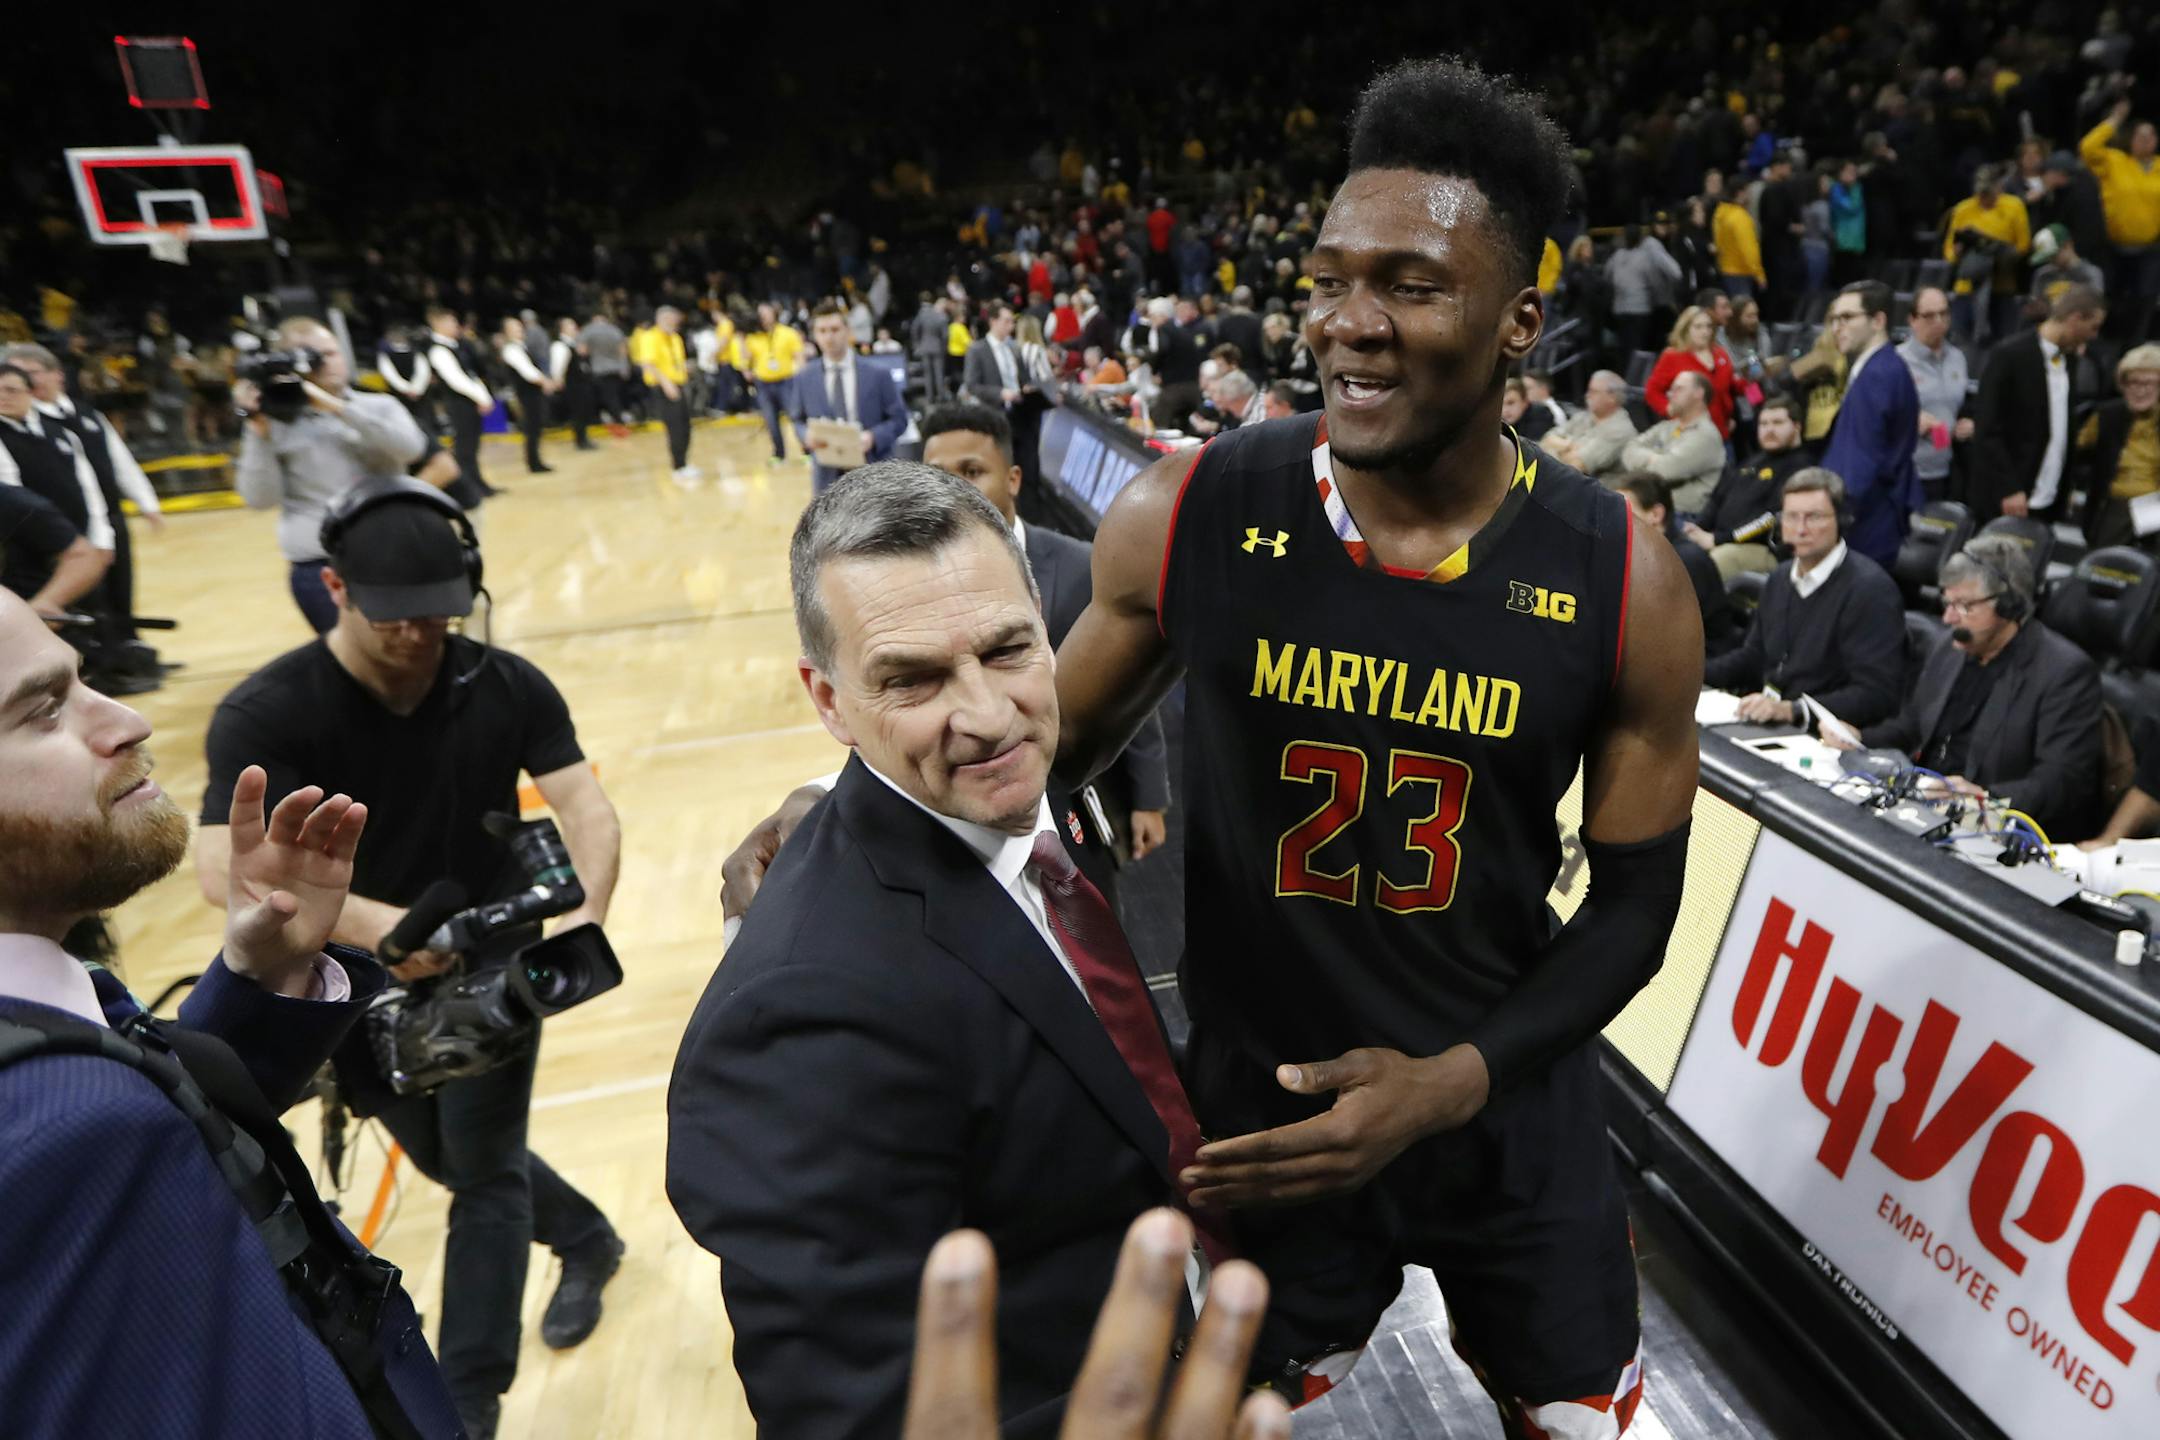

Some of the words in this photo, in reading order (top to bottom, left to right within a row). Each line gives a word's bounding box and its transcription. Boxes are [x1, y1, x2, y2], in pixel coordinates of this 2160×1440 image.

[1250, 638, 1522, 738] MARYLAND
[1275, 740, 1473, 914] 23
[1876, 1193, 2000, 1312] EMPLOYEE
[2006, 1307, 2114, 1411] OWNED
